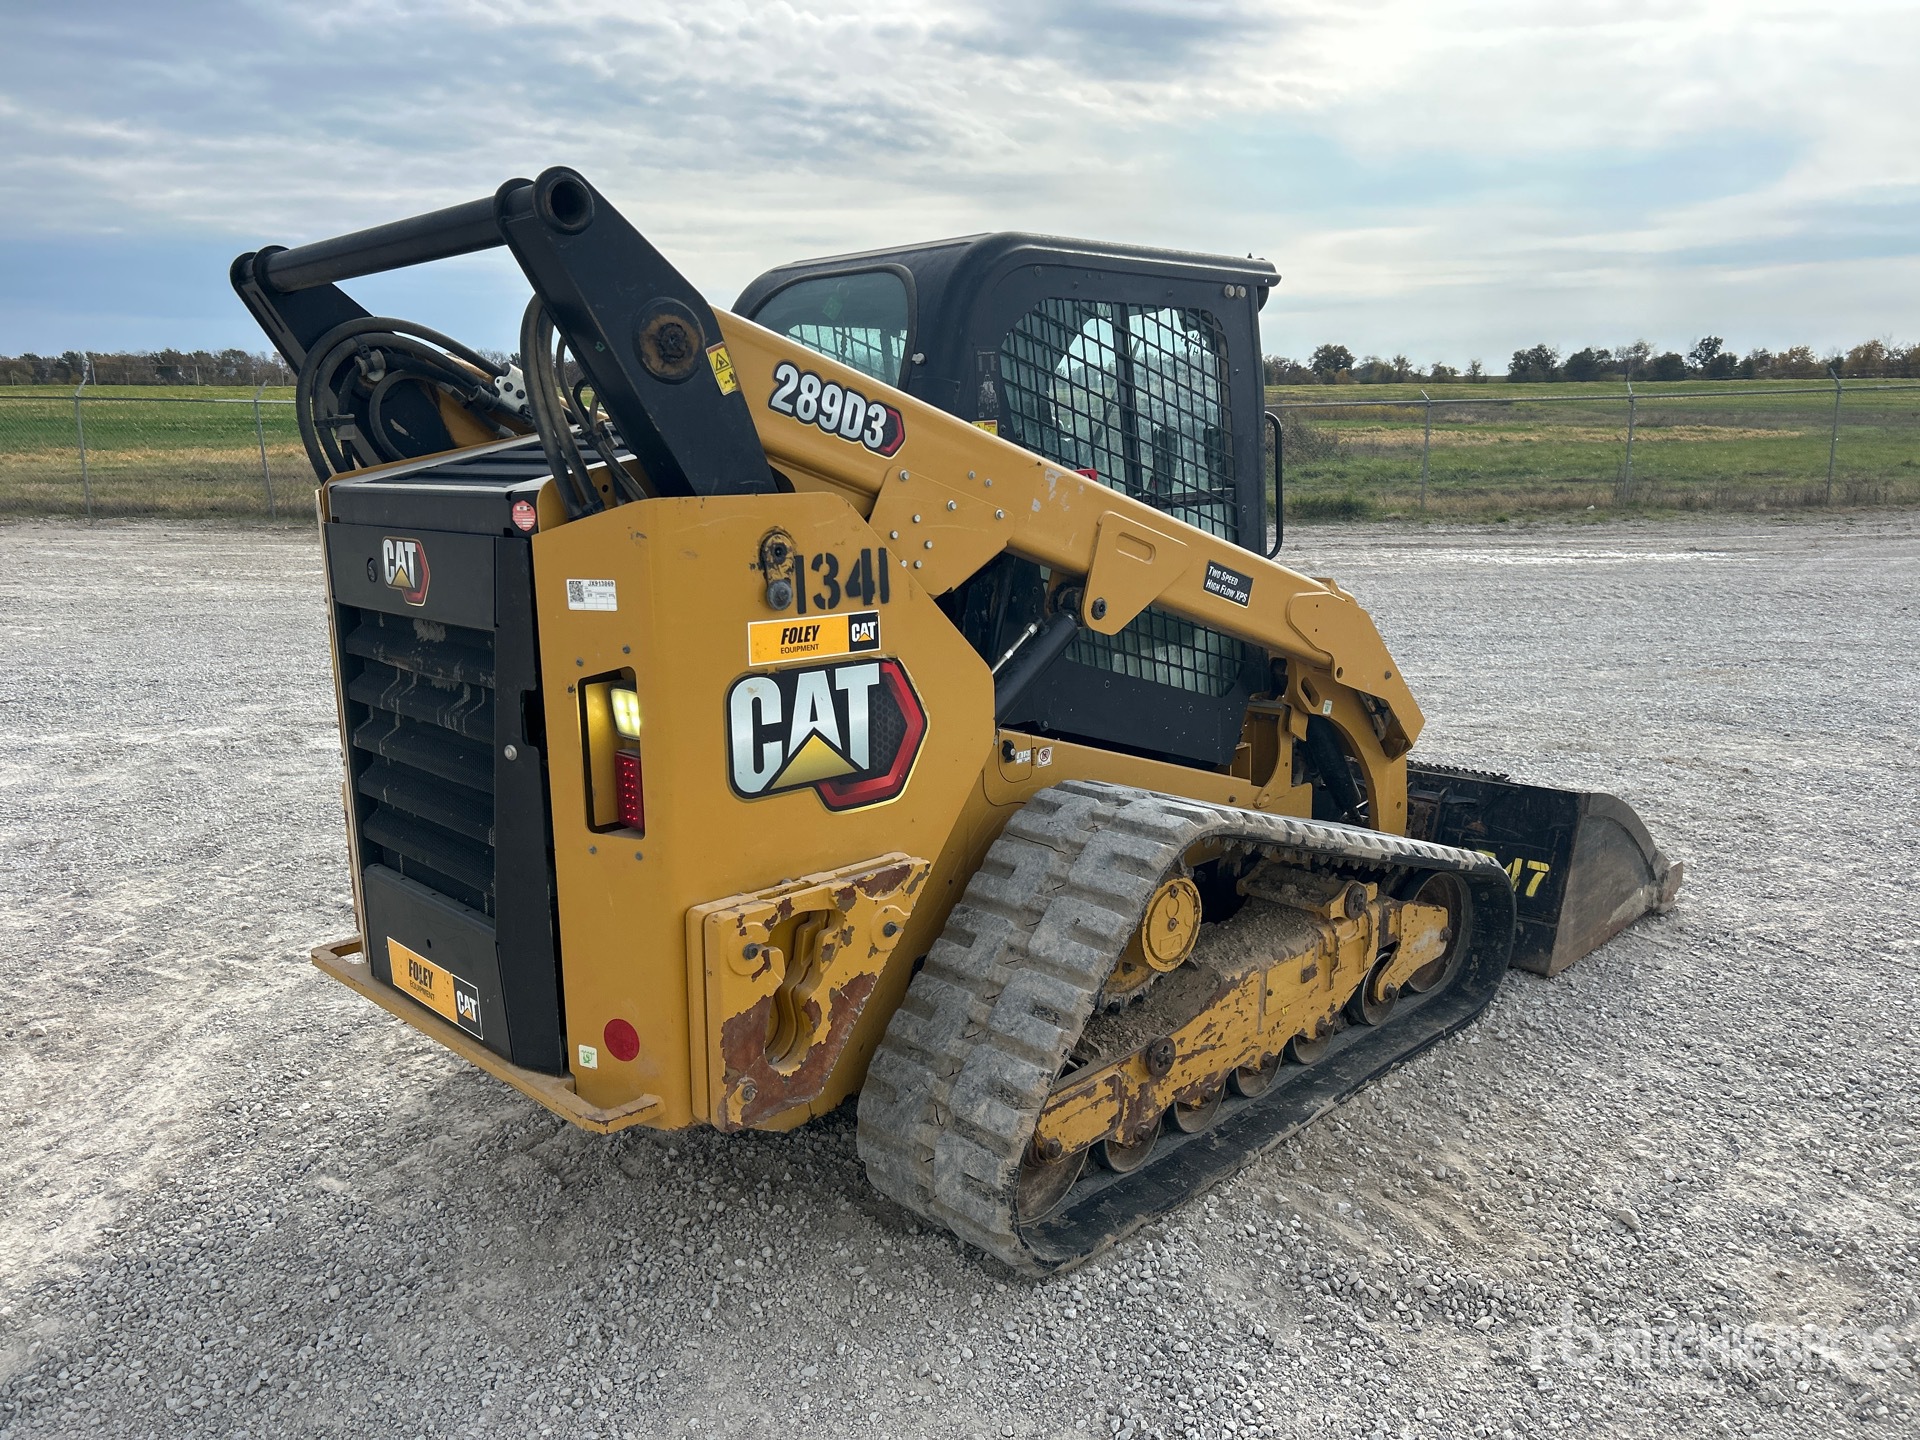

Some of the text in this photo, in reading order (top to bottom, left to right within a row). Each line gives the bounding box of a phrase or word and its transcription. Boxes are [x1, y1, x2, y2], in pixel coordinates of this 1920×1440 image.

[770, 363, 887, 449] 289D3
[382, 539, 417, 589] CAT
[794, 547, 890, 615] 1341
[1234, 590, 1248, 603] XPS
[780, 625, 821, 645] FOLEY
[851, 621, 876, 643] CAT
[780, 643, 819, 655] EQUIPMENT
[730, 662, 880, 794] CAT
[408, 958, 434, 990] FOLEY
[409, 980, 435, 1002] EQUIPMENT
[456, 990, 478, 1023] CAT
